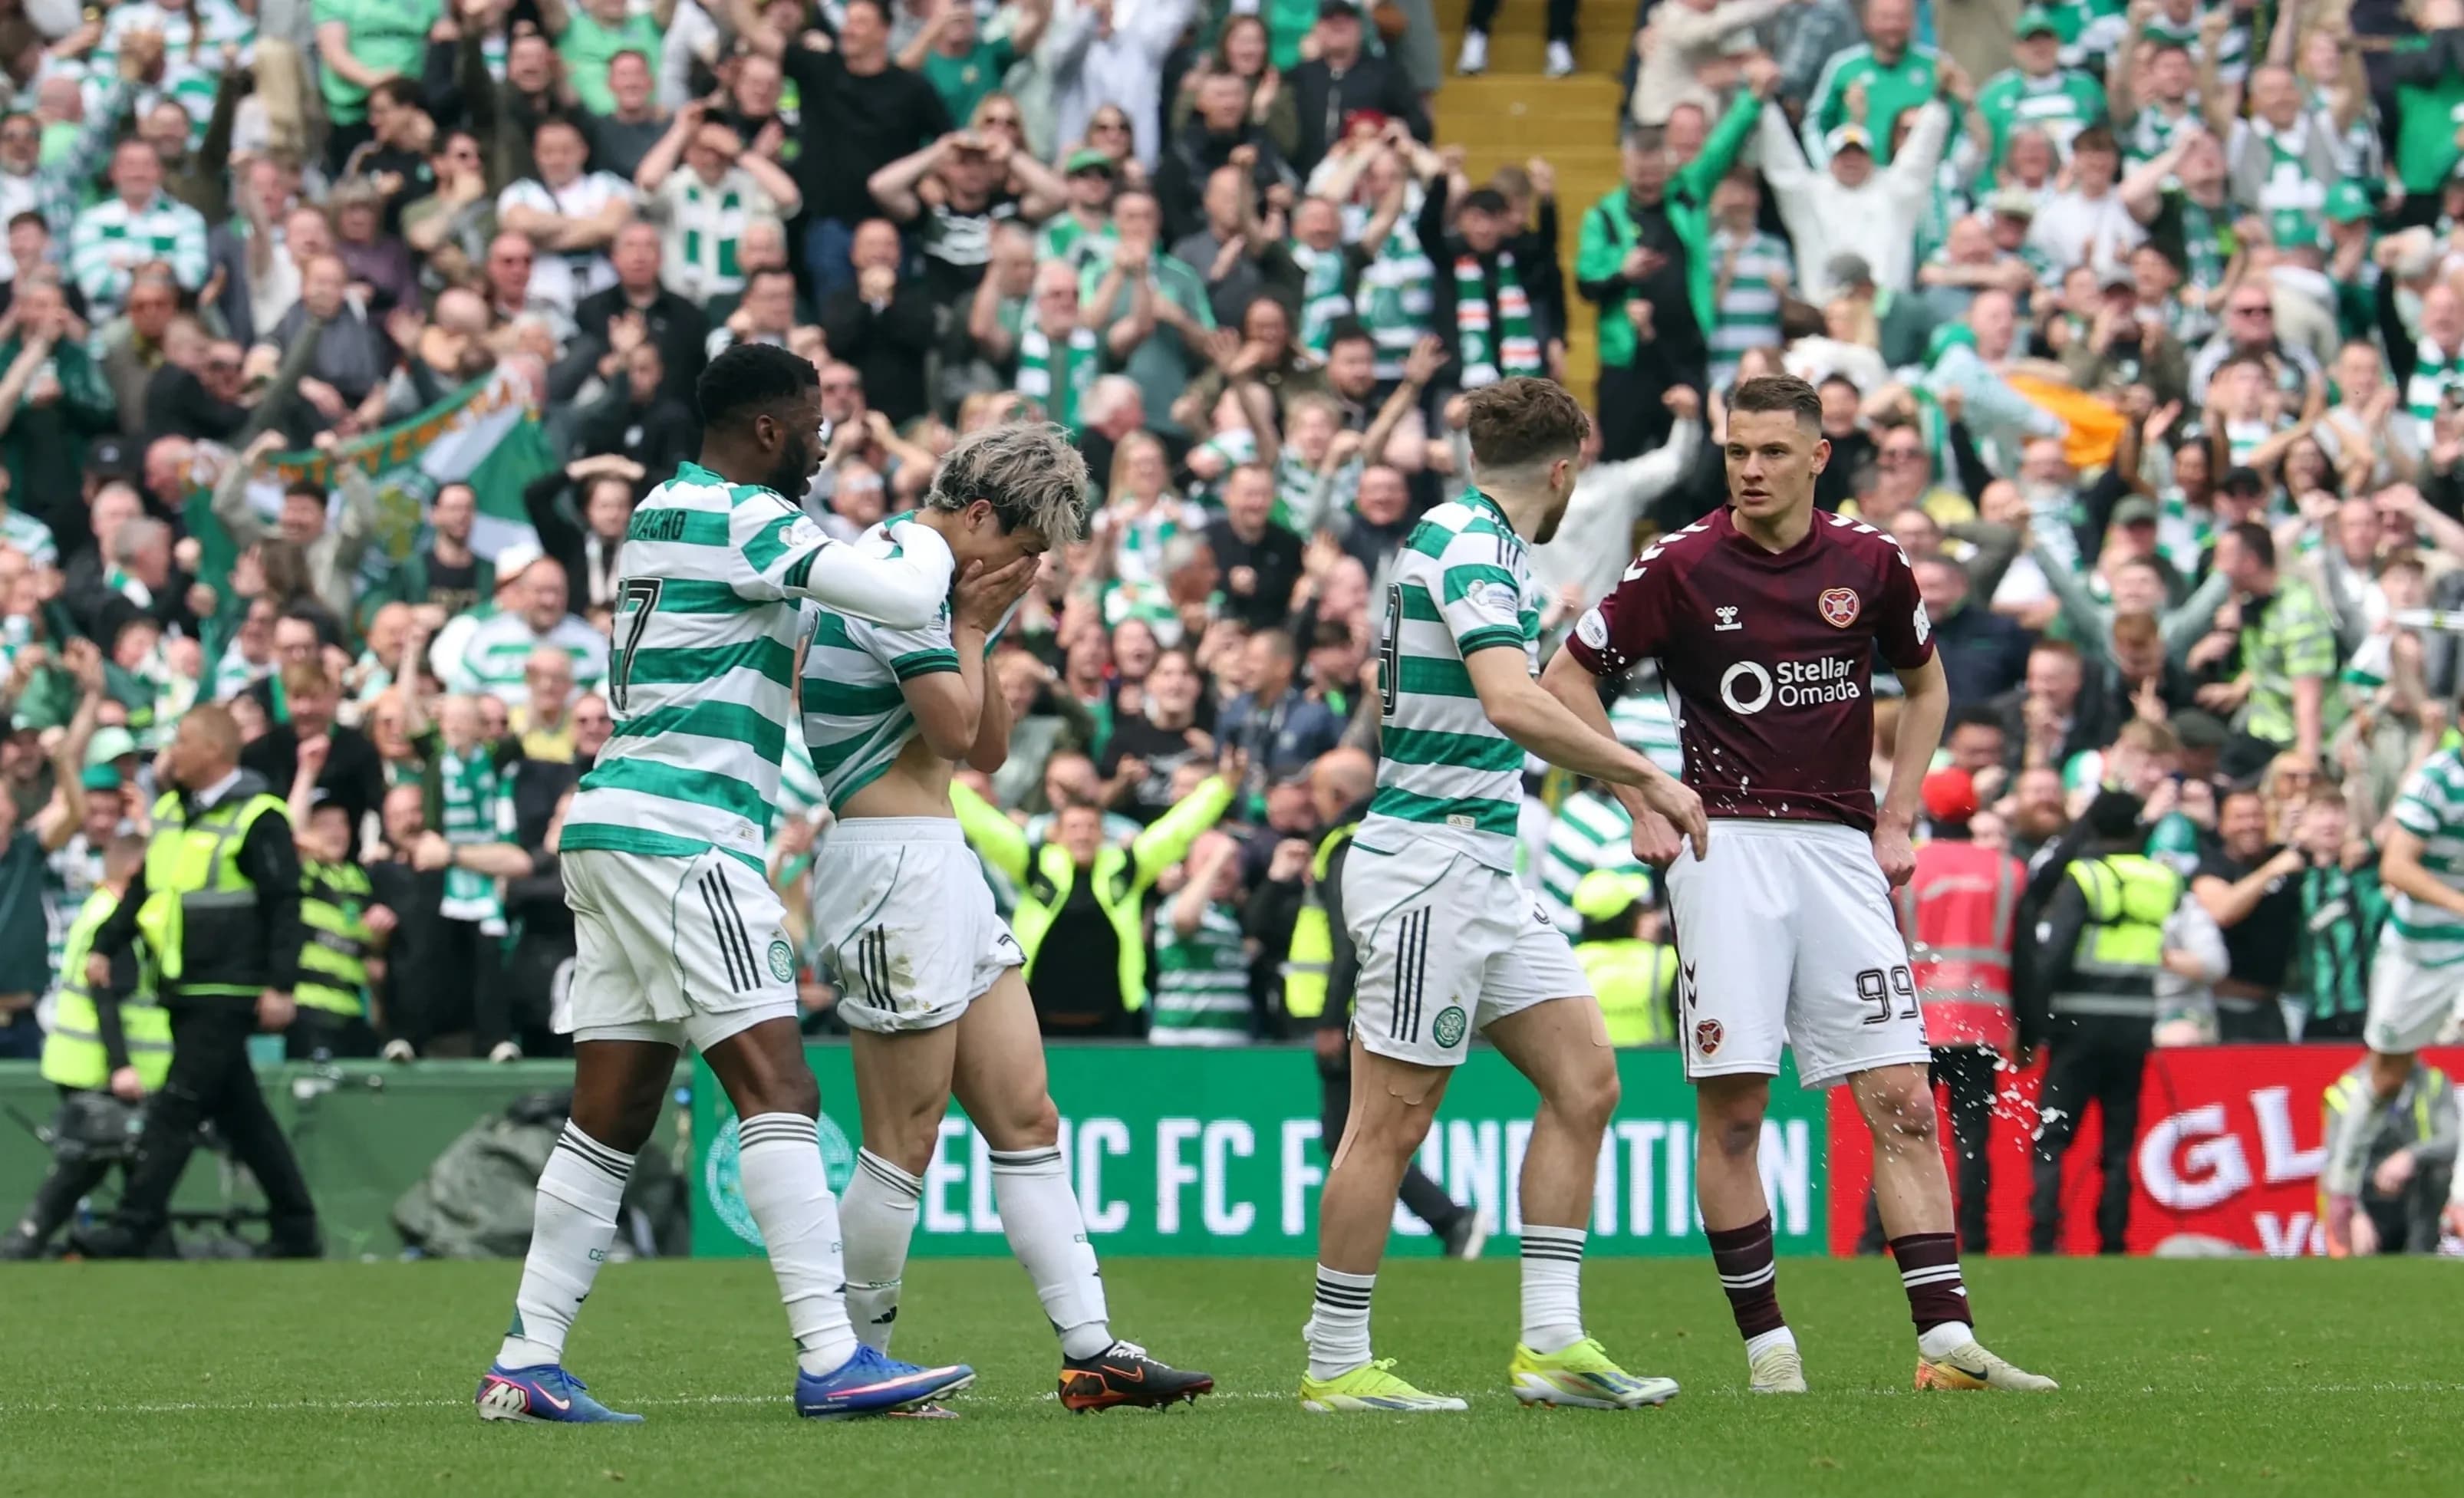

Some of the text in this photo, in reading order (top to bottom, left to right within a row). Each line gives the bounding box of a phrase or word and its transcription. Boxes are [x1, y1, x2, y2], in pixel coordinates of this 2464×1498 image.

[1776, 657, 1855, 684] Stellar
[1777, 677, 1861, 706] Omada
[1856, 965, 1919, 1024] 99
[1157, 1118, 1255, 1234] FC
